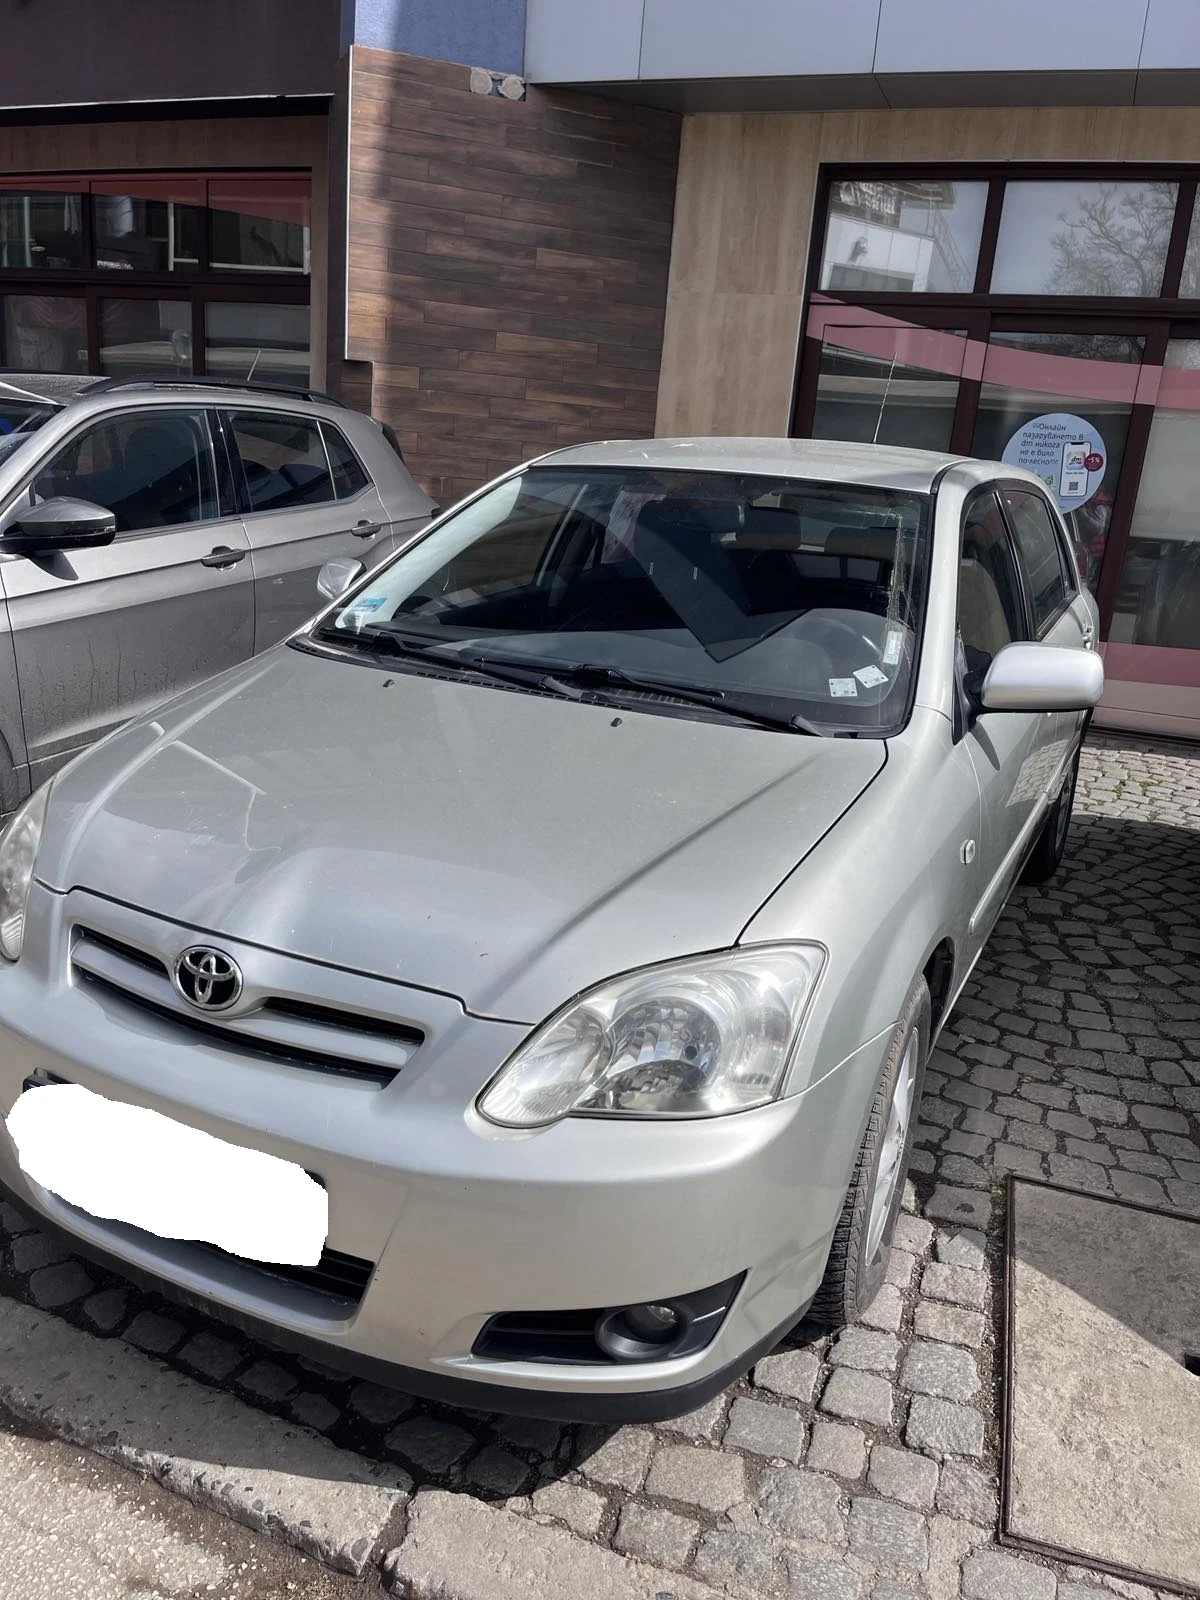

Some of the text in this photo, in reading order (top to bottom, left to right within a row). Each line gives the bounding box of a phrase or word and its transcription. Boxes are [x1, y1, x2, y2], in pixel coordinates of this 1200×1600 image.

[1023, 431, 1076, 441] пазаруването
[1035, 441, 1060, 449] никога
[1037, 449, 1055, 457] било
